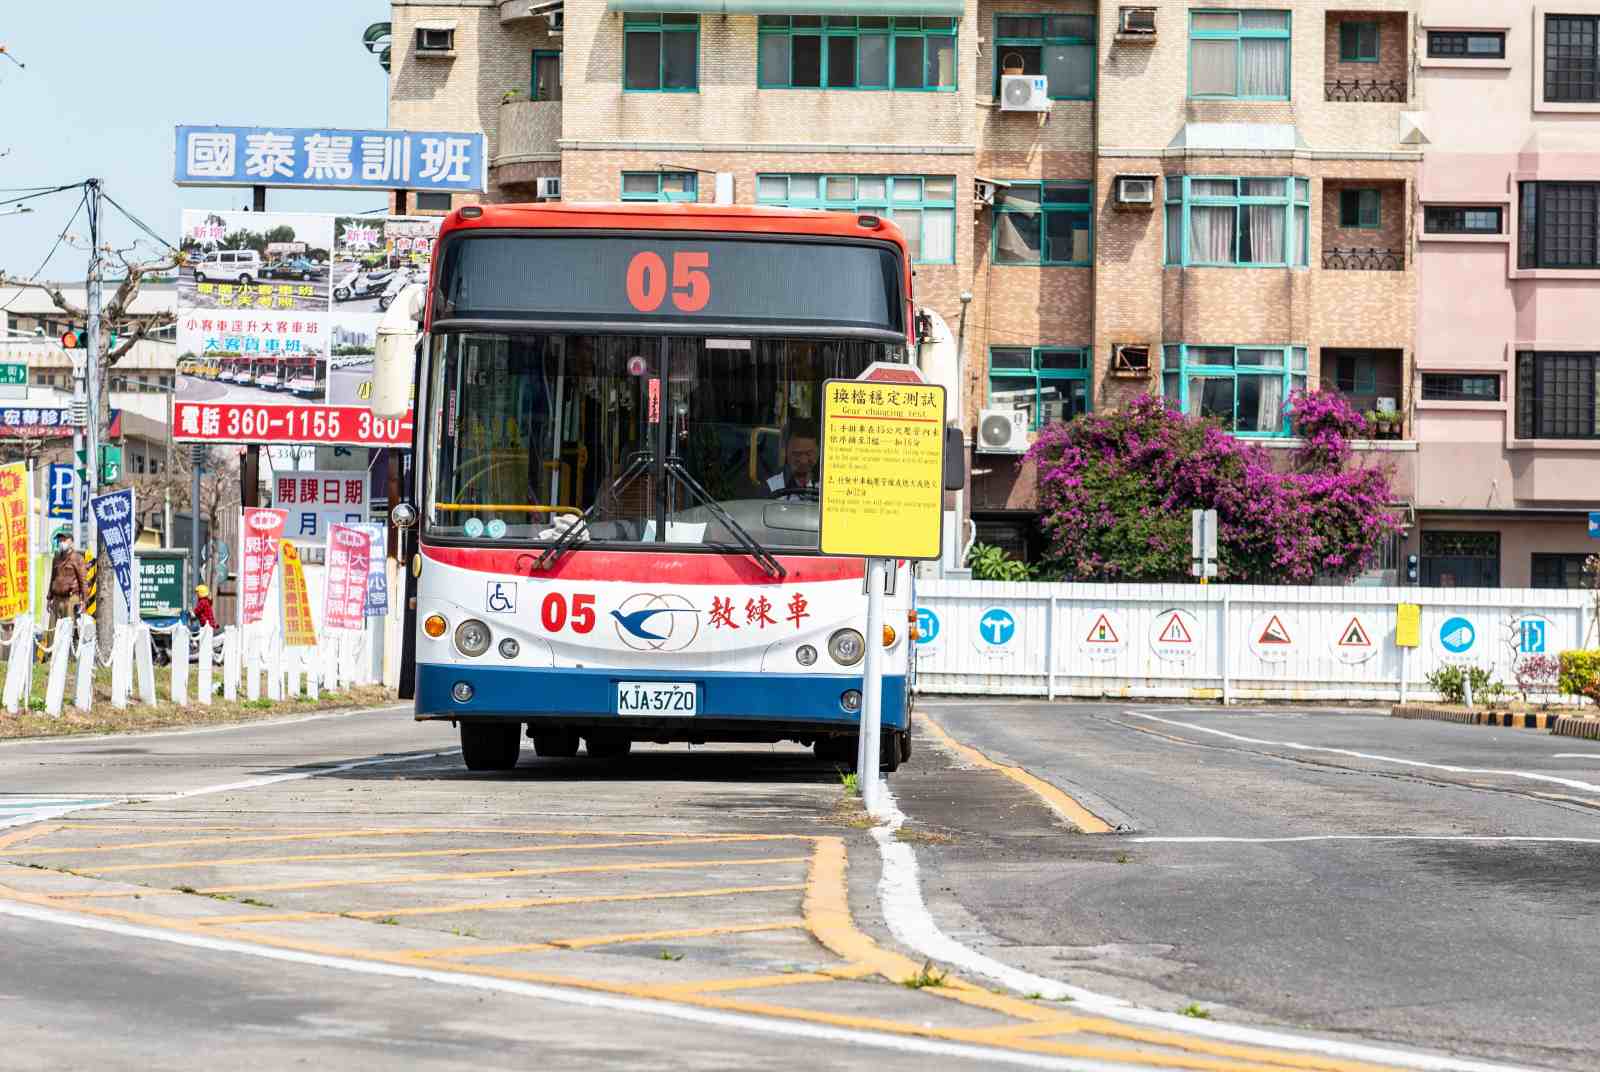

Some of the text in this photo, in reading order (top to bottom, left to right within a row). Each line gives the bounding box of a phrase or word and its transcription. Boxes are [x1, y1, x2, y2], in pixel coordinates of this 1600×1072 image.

[186, 131, 473, 184] 國泰駕訓班
[626, 251, 711, 312] 05
[833, 388, 937, 408] 換檔穩定測試
[181, 406, 221, 435] 電話
[227, 408, 341, 438] 360-1155
[277, 478, 364, 504] 開課日期
[299, 512, 317, 535] 月
[541, 592, 596, 634] 05
[708, 592, 811, 629] 教練車
